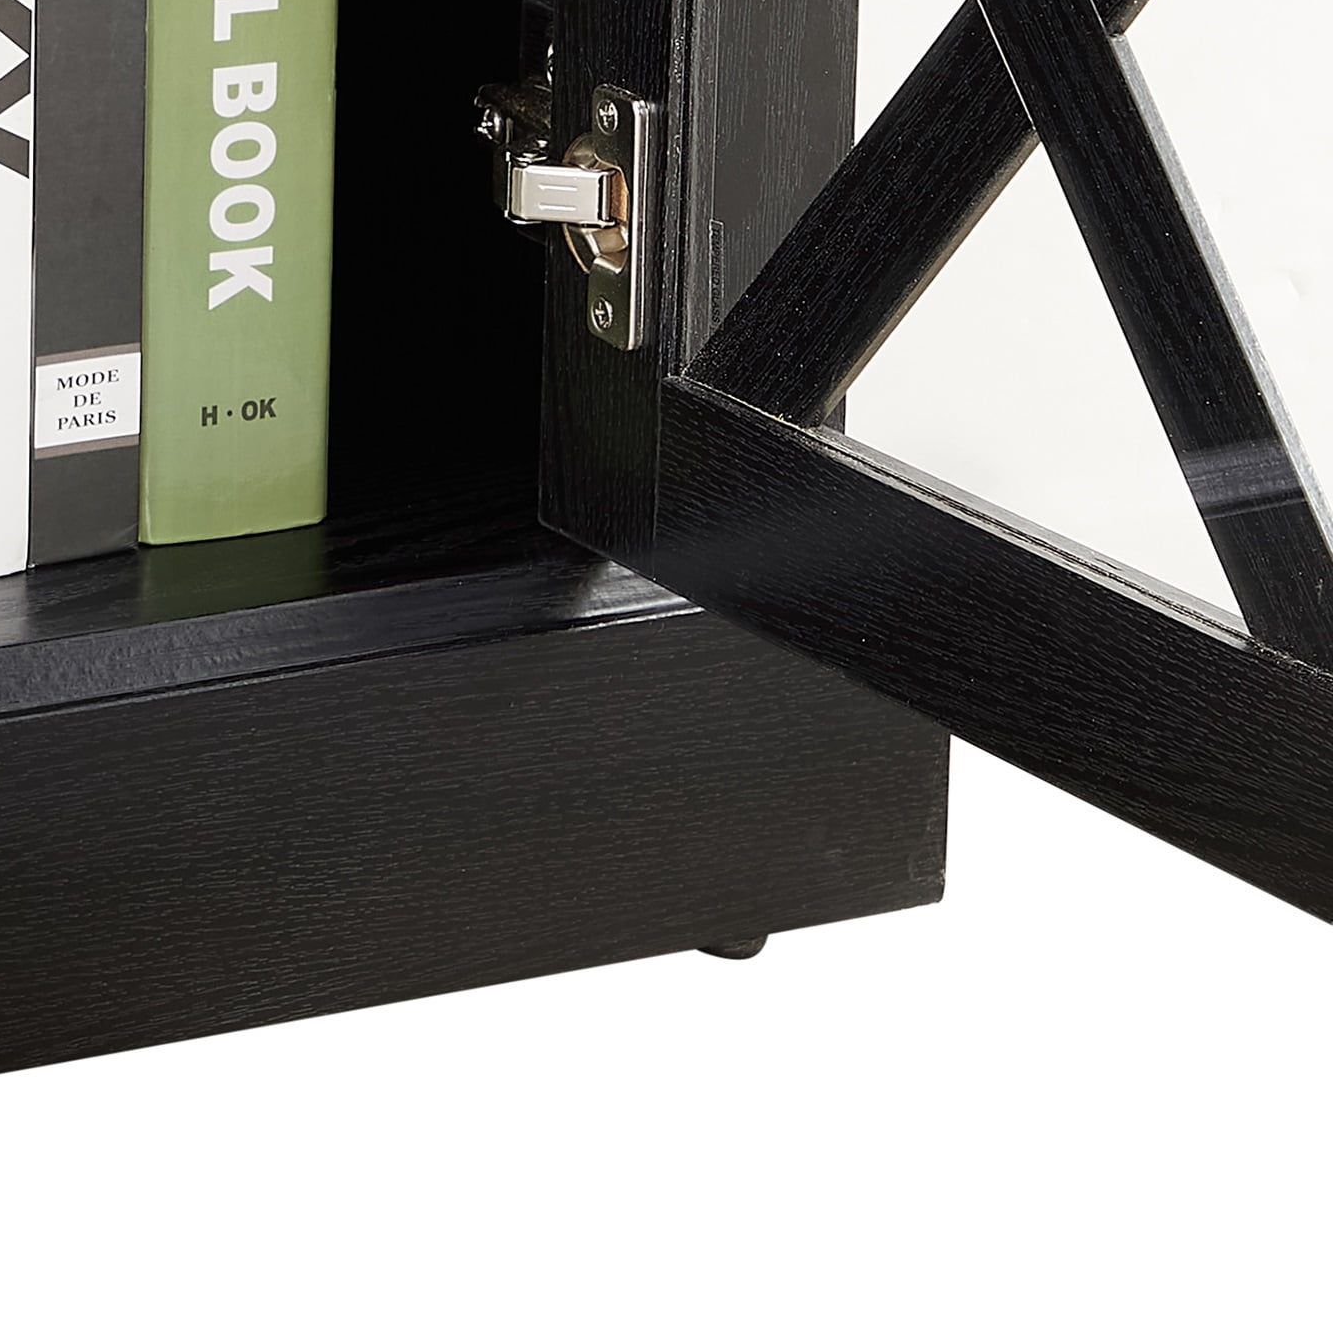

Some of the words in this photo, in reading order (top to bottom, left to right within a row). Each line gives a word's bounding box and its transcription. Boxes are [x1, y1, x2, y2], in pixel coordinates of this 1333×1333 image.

[208, 61, 279, 311] BOOK
[57, 369, 120, 391] MODE
[74, 391, 102, 408] DE
[58, 410, 117, 431] PARIS
